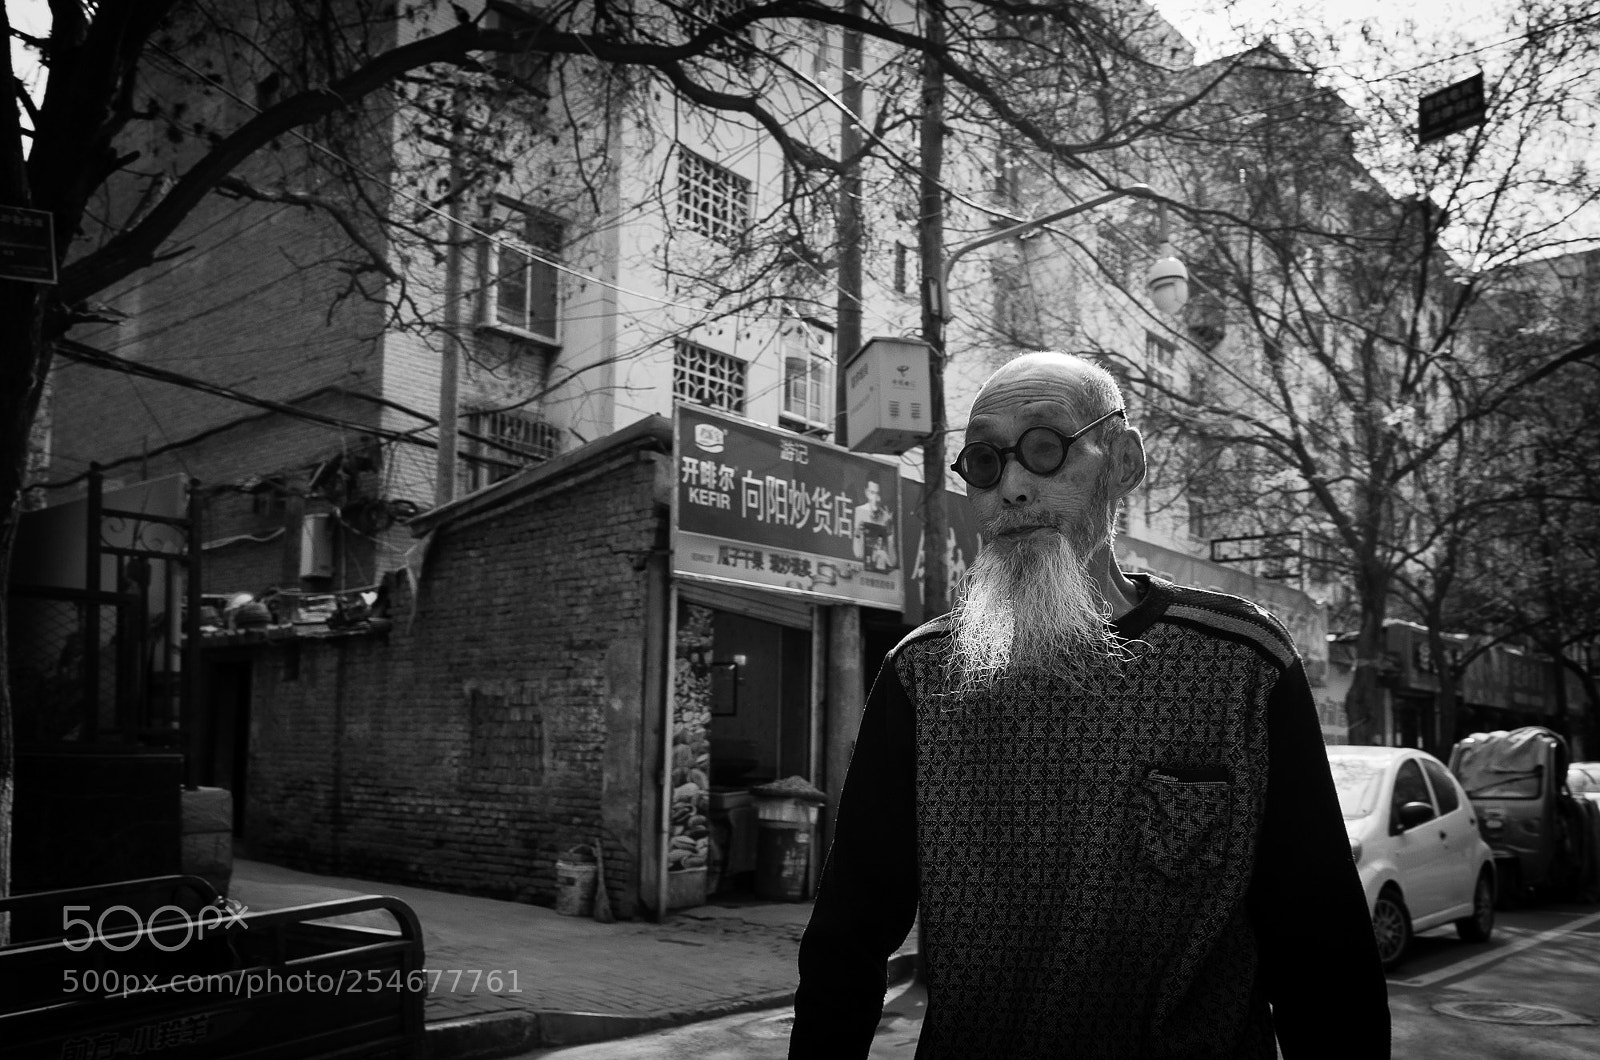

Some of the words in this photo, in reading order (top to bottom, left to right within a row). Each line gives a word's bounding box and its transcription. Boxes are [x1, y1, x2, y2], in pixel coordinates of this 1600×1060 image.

[688, 487, 731, 510] KEFIR
[741, 469, 853, 540] 向阳炒货店
